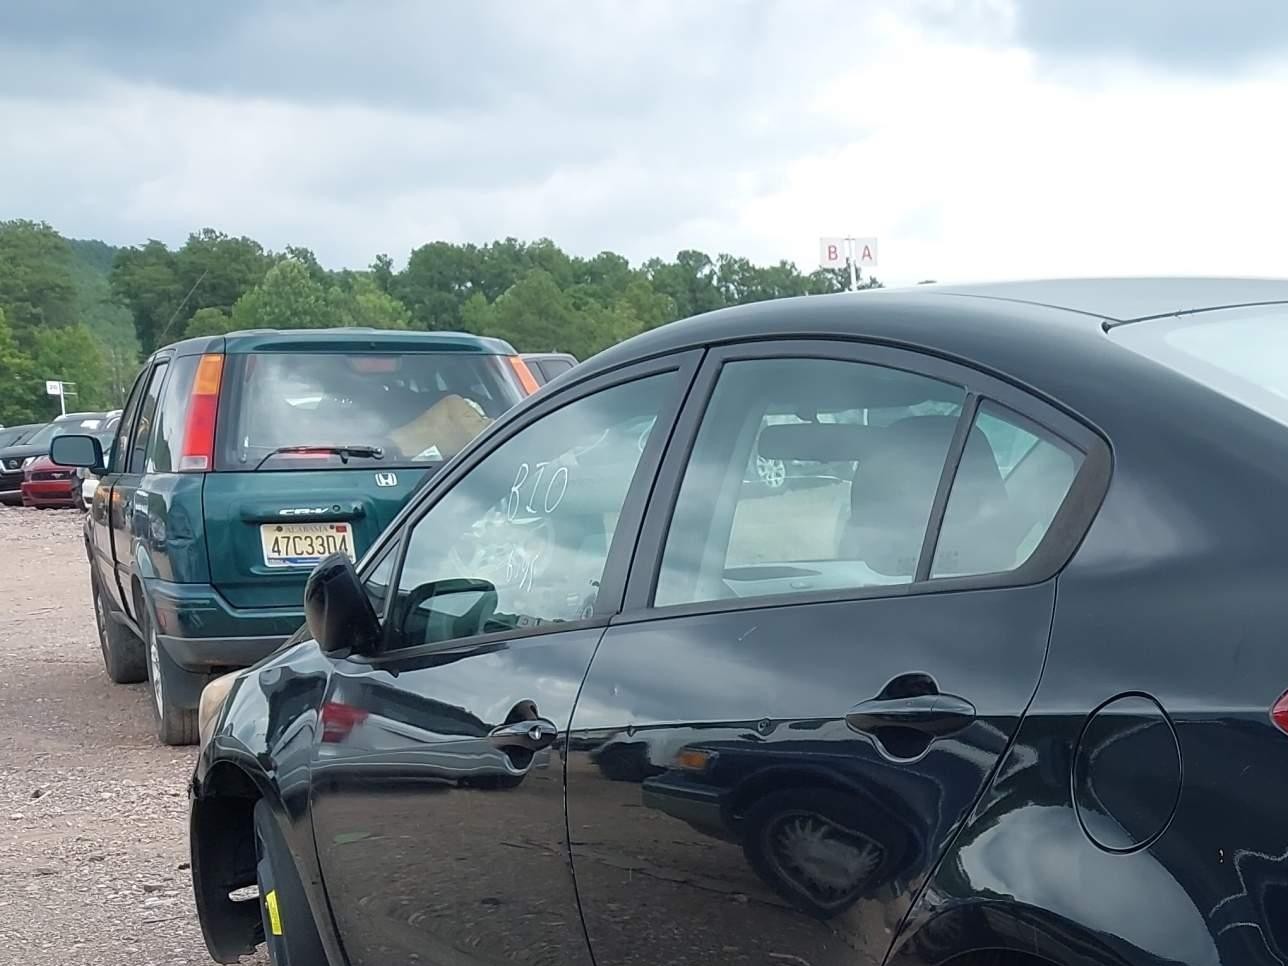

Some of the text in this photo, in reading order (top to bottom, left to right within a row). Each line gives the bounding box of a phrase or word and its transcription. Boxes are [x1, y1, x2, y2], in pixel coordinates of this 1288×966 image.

[828, 244, 839, 261] B
[862, 244, 873, 261] A
[279, 507, 329, 516] CR-V
